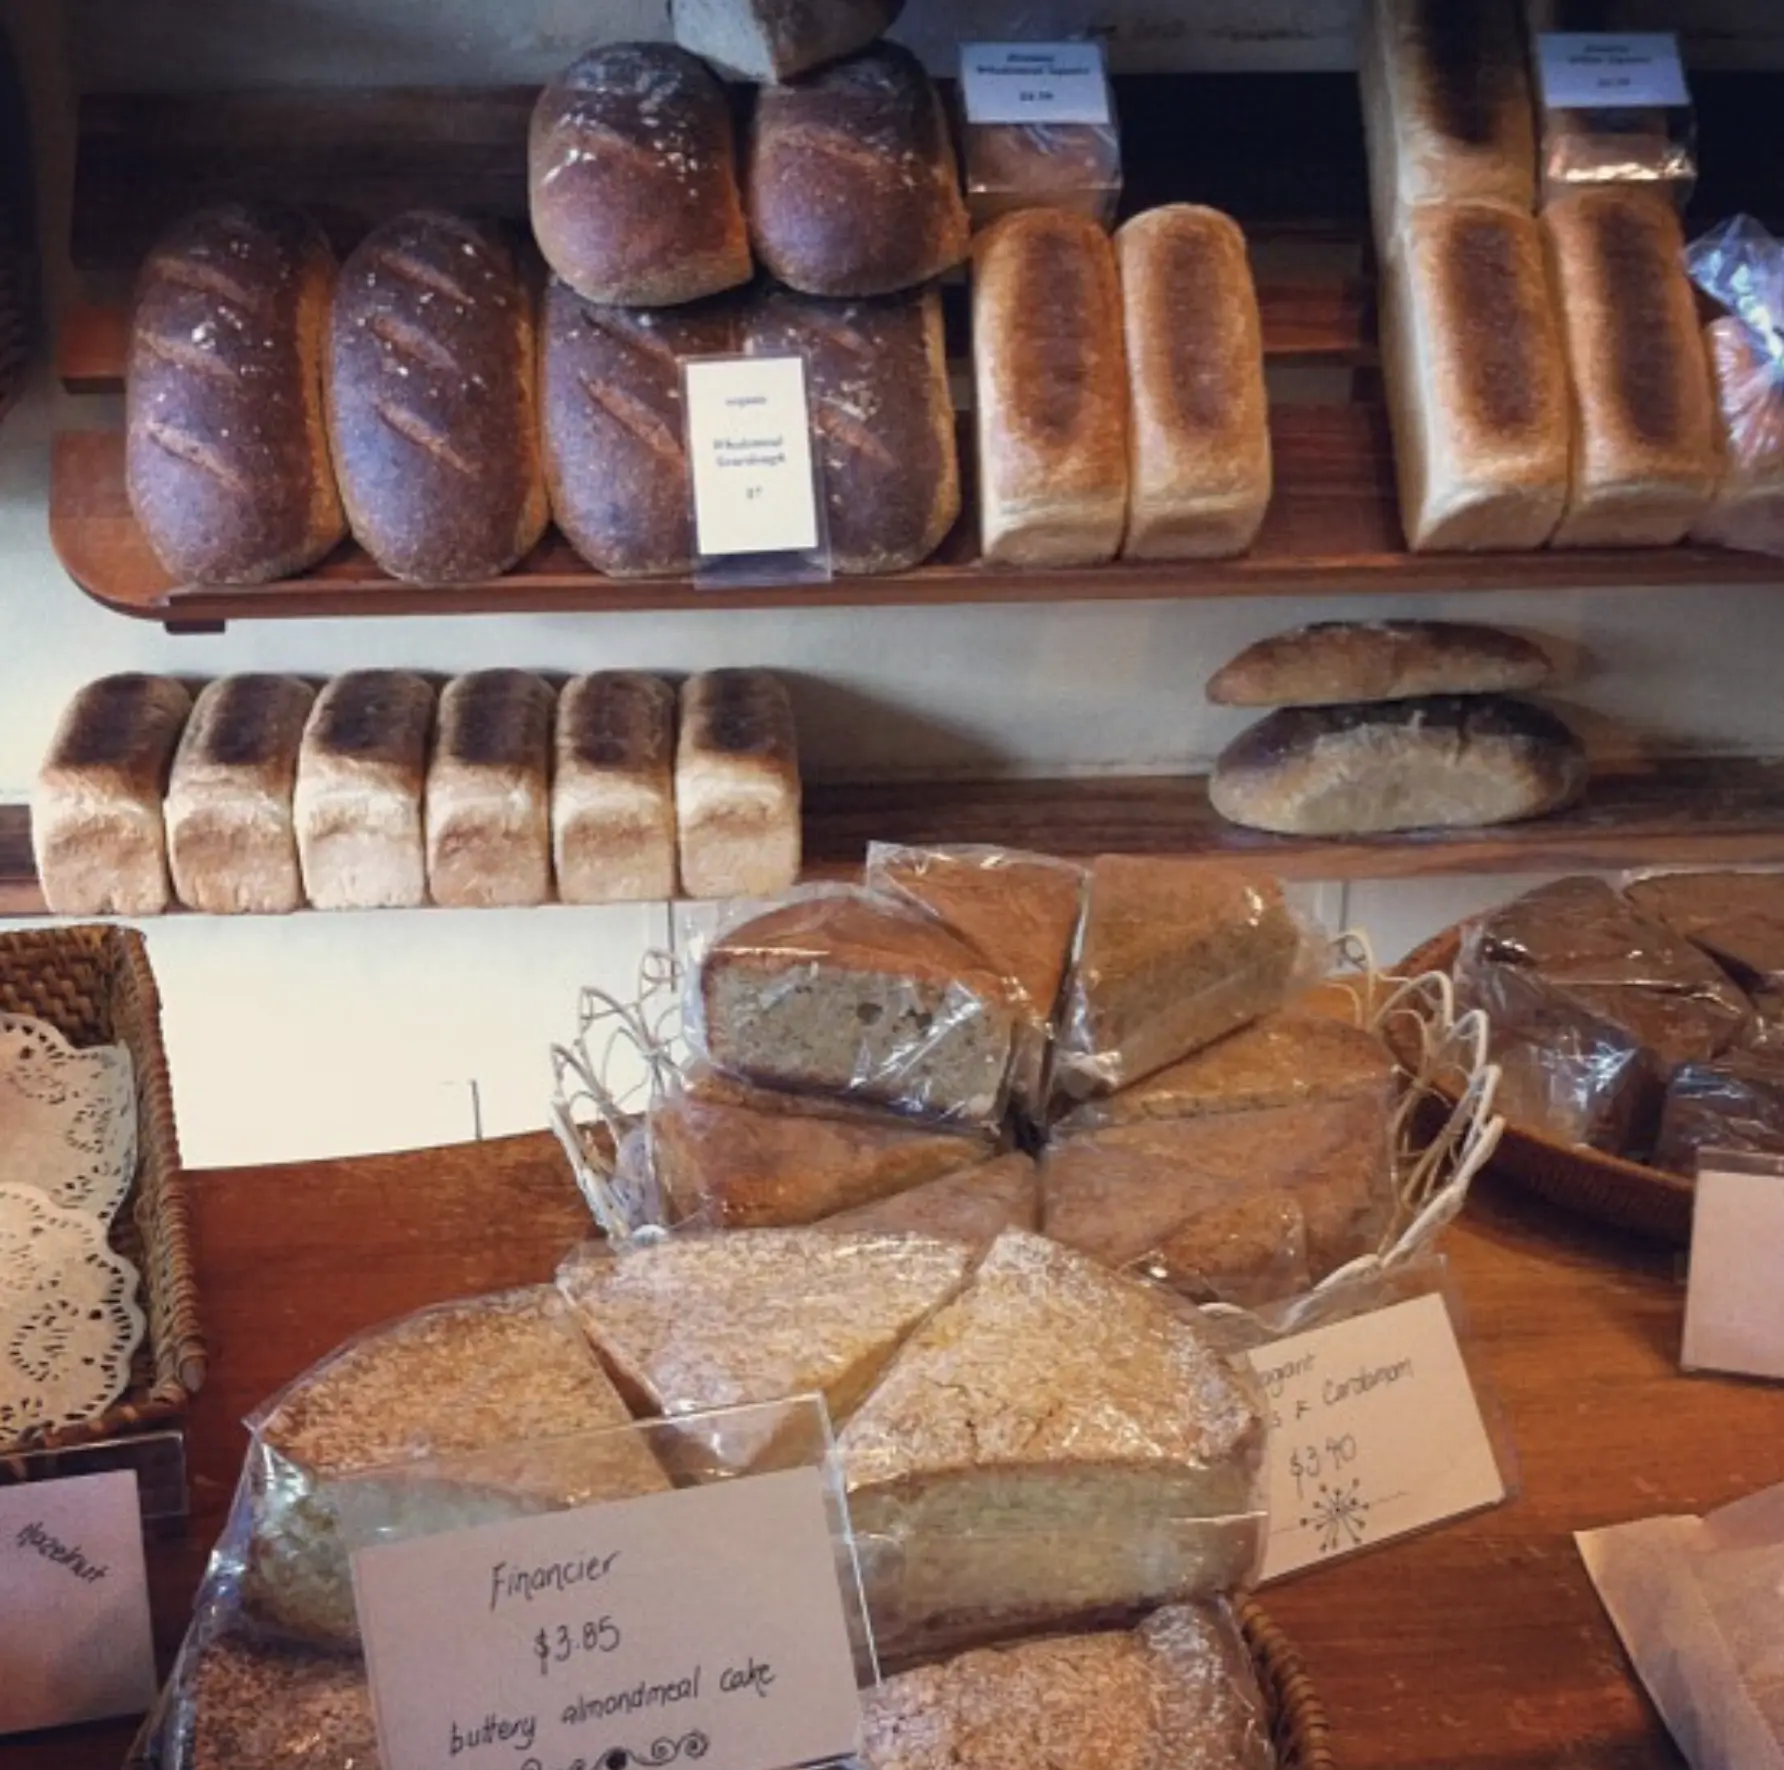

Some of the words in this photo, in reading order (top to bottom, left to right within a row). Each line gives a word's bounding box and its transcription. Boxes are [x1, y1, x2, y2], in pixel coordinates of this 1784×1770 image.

[490, 1551, 623, 1612] Financier
[533, 1614, 621, 1676] $3.85
[450, 1714, 537, 1757] buttery
[561, 1665, 702, 1726] almondmeal
[719, 1657, 777, 1697] cake
